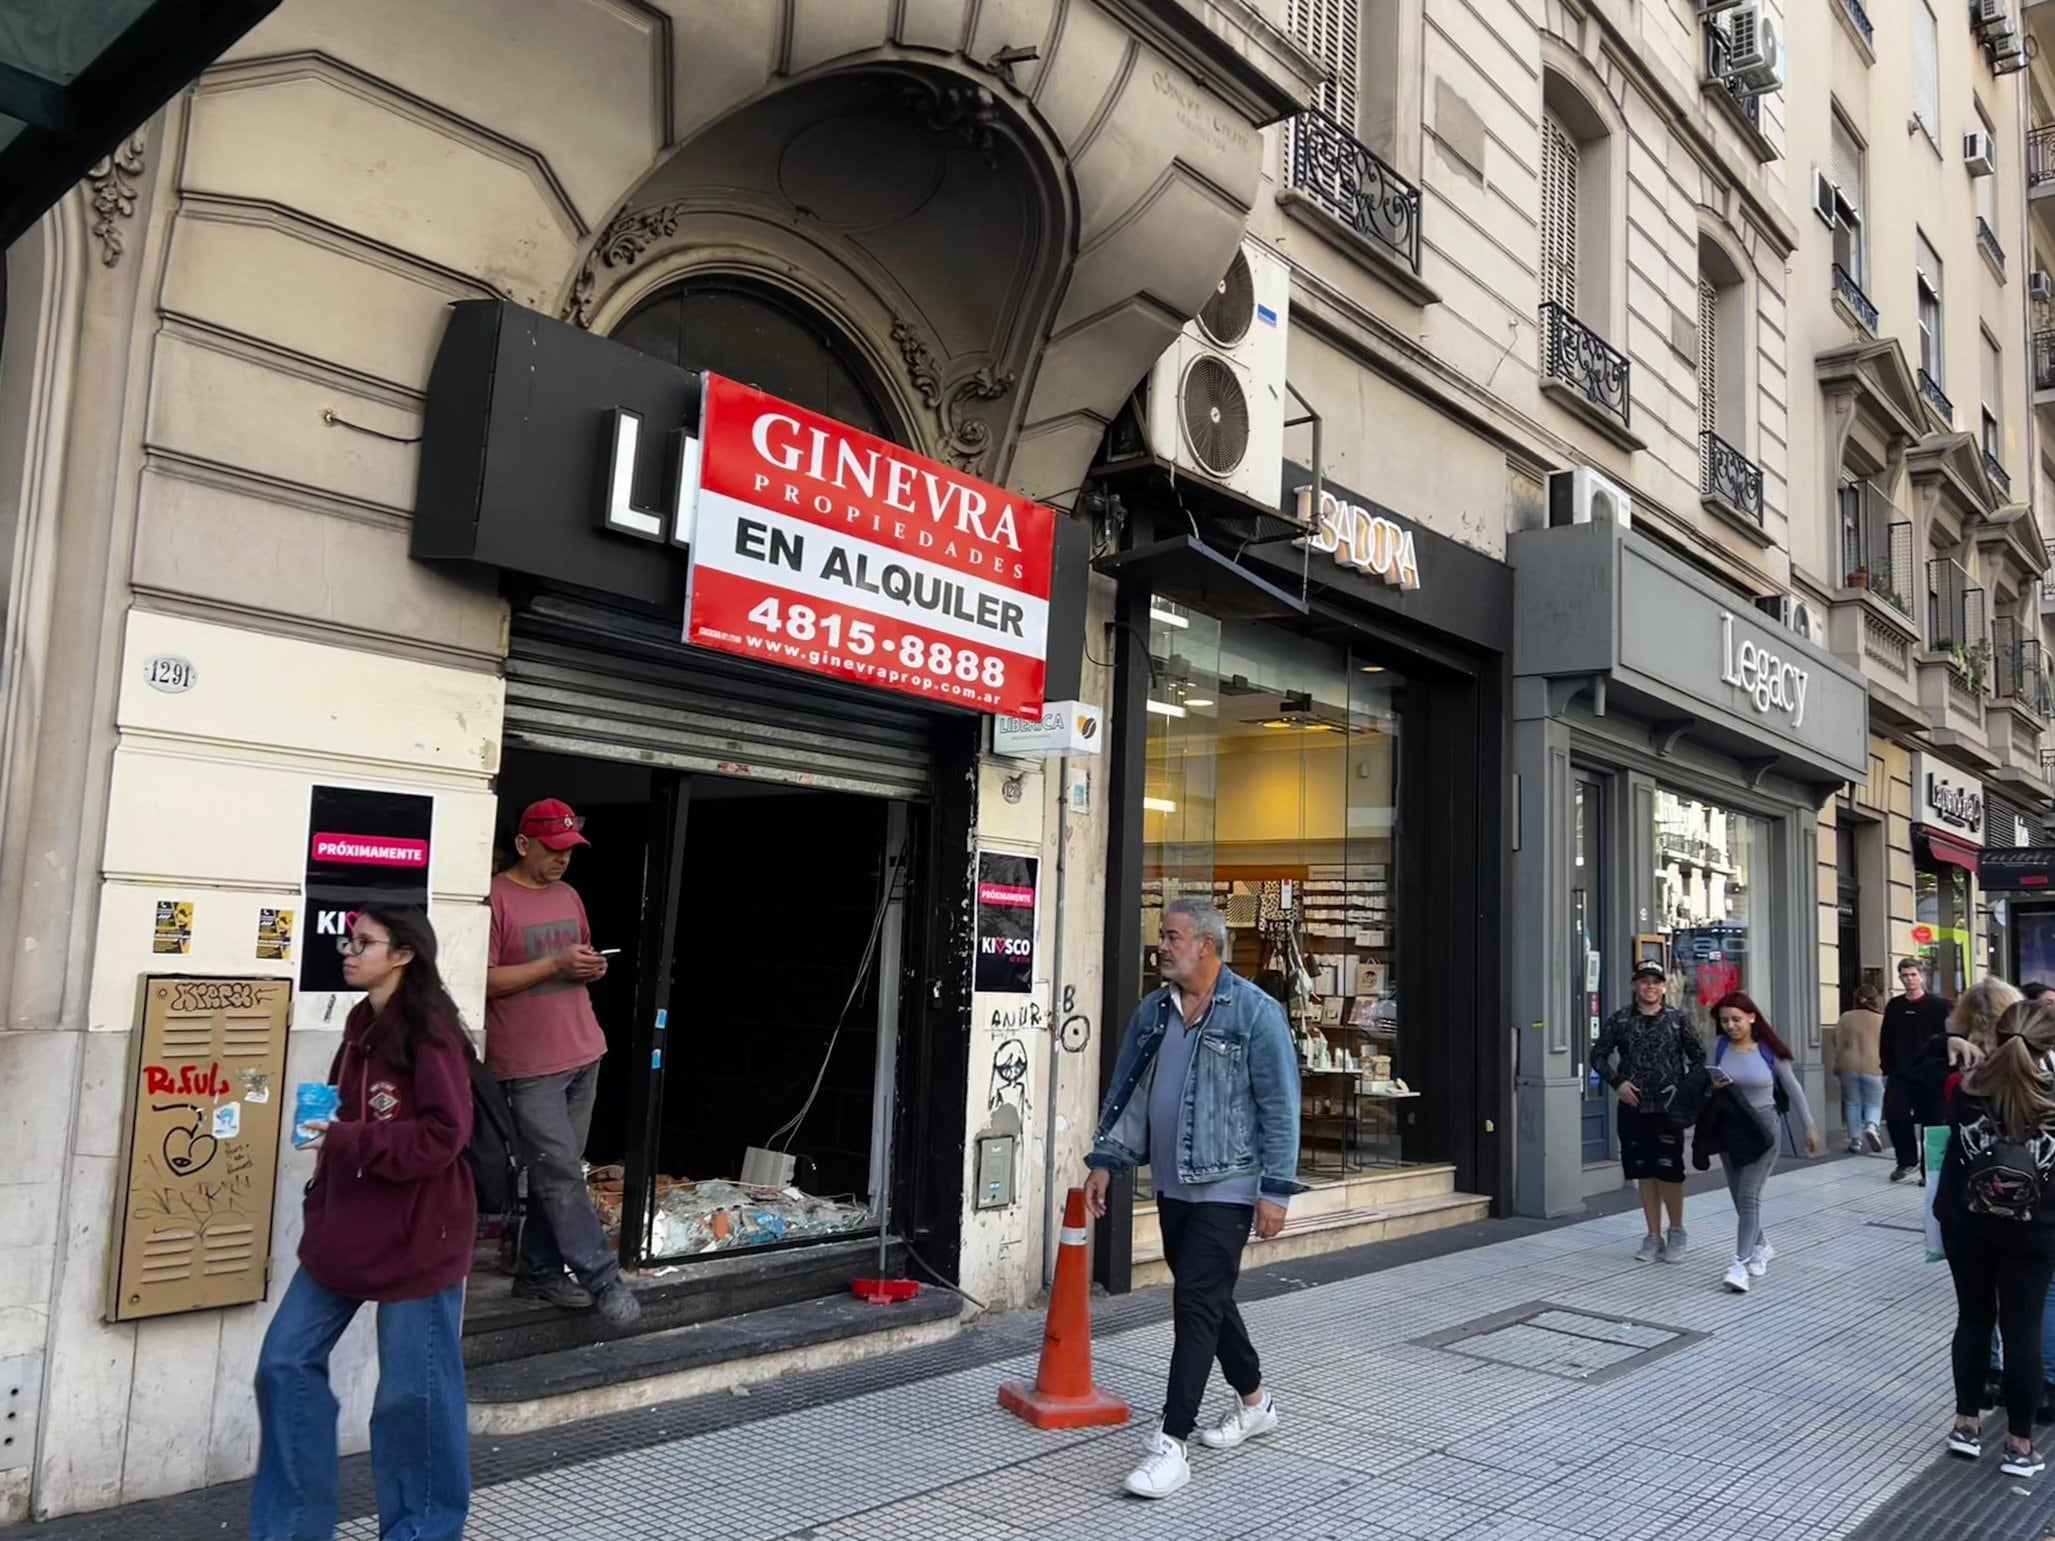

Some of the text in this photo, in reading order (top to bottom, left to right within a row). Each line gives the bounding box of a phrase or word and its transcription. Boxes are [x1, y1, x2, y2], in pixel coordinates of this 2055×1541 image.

[751, 412, 1022, 552] GINEVRA
[753, 473, 1024, 579] PROPIEDADES
[735, 516, 1024, 638] EN ALQUILER
[149, 658, 191, 688] 1291
[745, 635, 1002, 705] www.ginevraprop.com.ar
[1720, 611, 1809, 728] Legacy
[317, 840, 423, 861] PRÓXIMAMENTE
